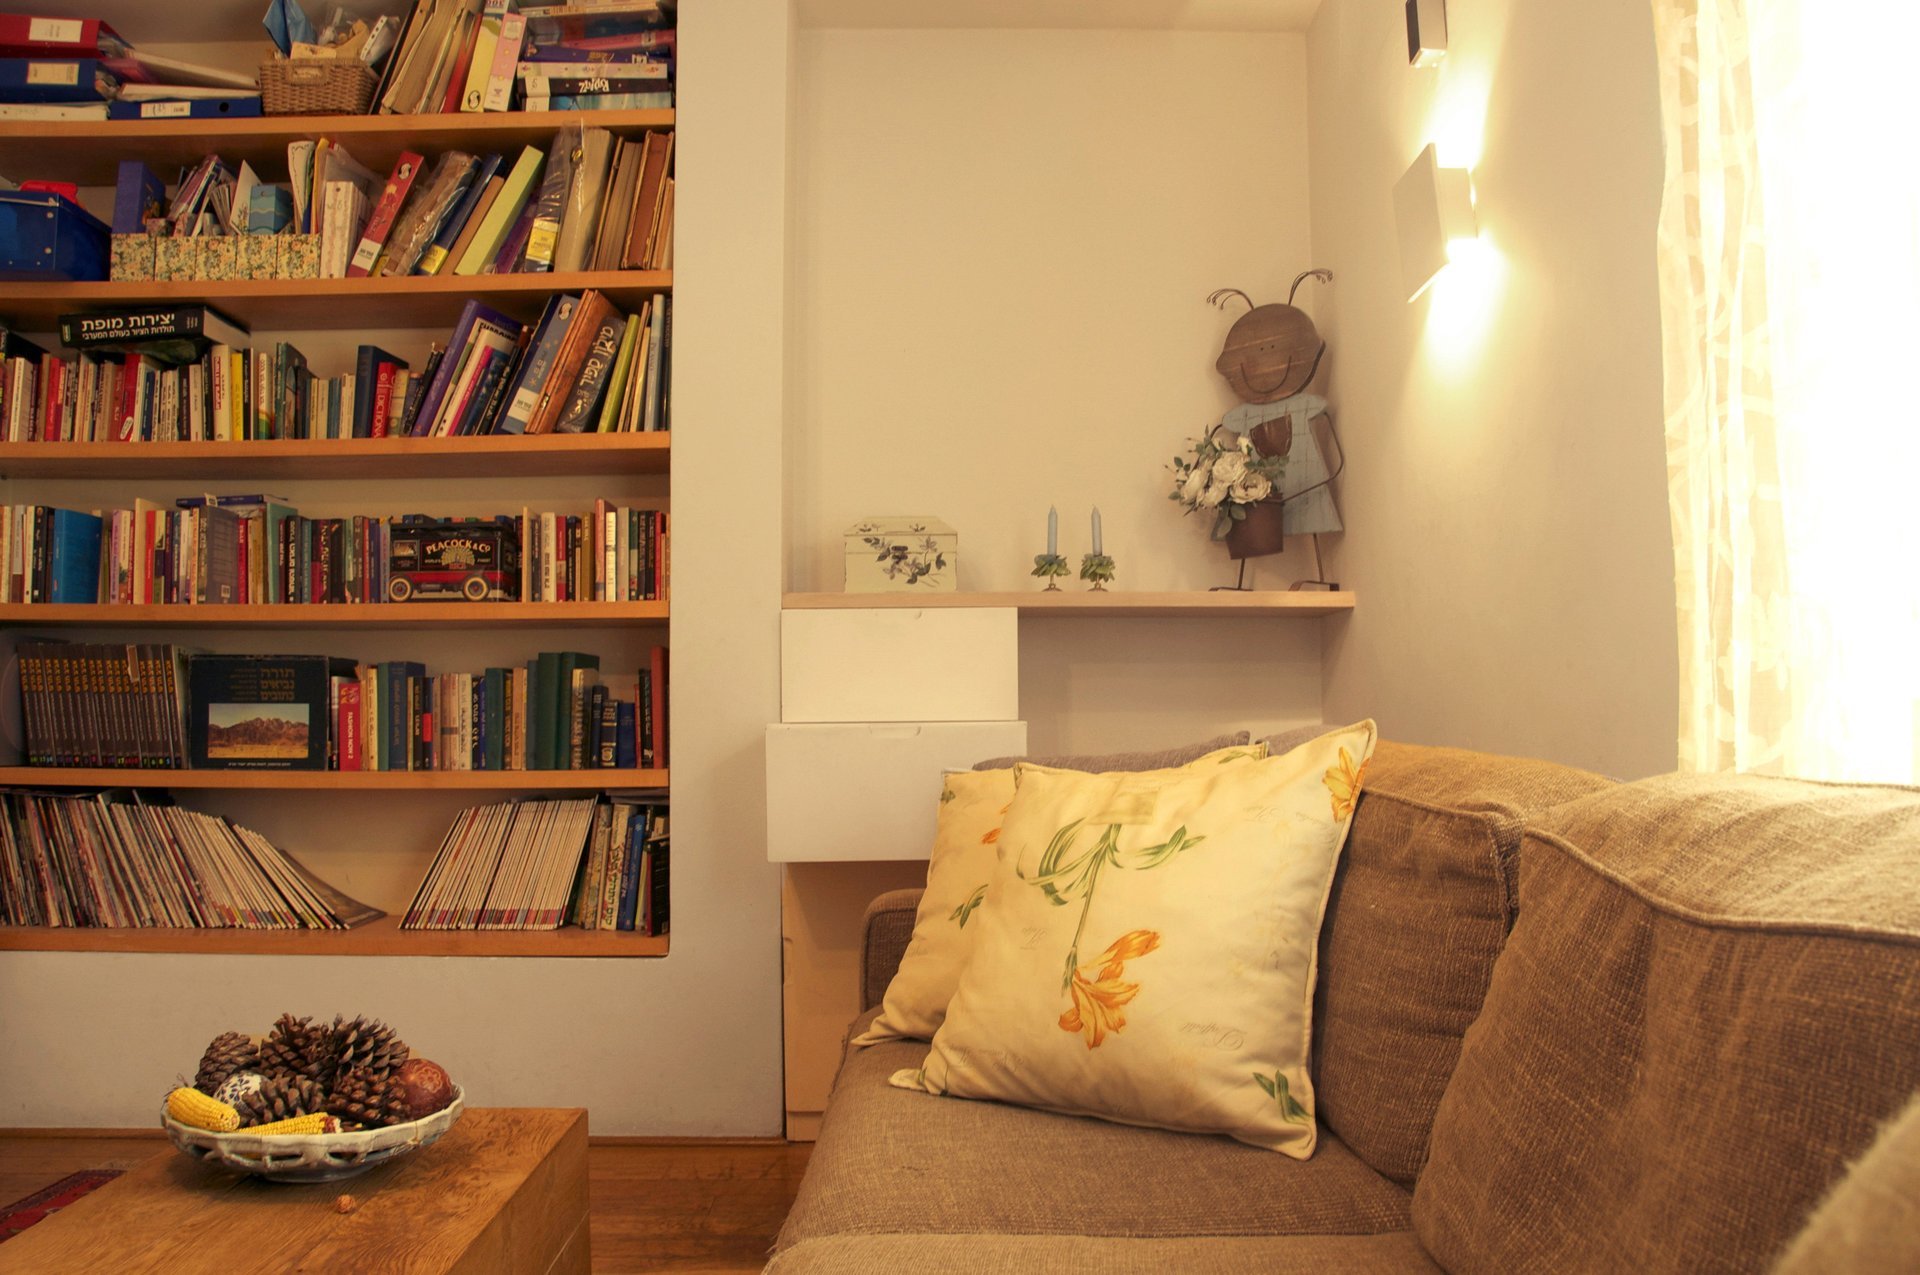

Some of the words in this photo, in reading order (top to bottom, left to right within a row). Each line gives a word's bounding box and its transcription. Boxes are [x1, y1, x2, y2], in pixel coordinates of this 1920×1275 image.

[81, 316, 124, 332] מופת
[128, 312, 176, 328] יצירות
[132, 327, 150, 336] הציור
[151, 325, 176, 333] תולדות
[579, 357, 604, 387] ספיר
[425, 539, 473, 555] PEACOCK
[260, 667, 295, 679] תורה
[260, 680, 295, 690] נביאים
[260, 690, 295, 701] כתובים
[346, 711, 354, 738] FASHION
[346, 738, 354, 754] NOW
